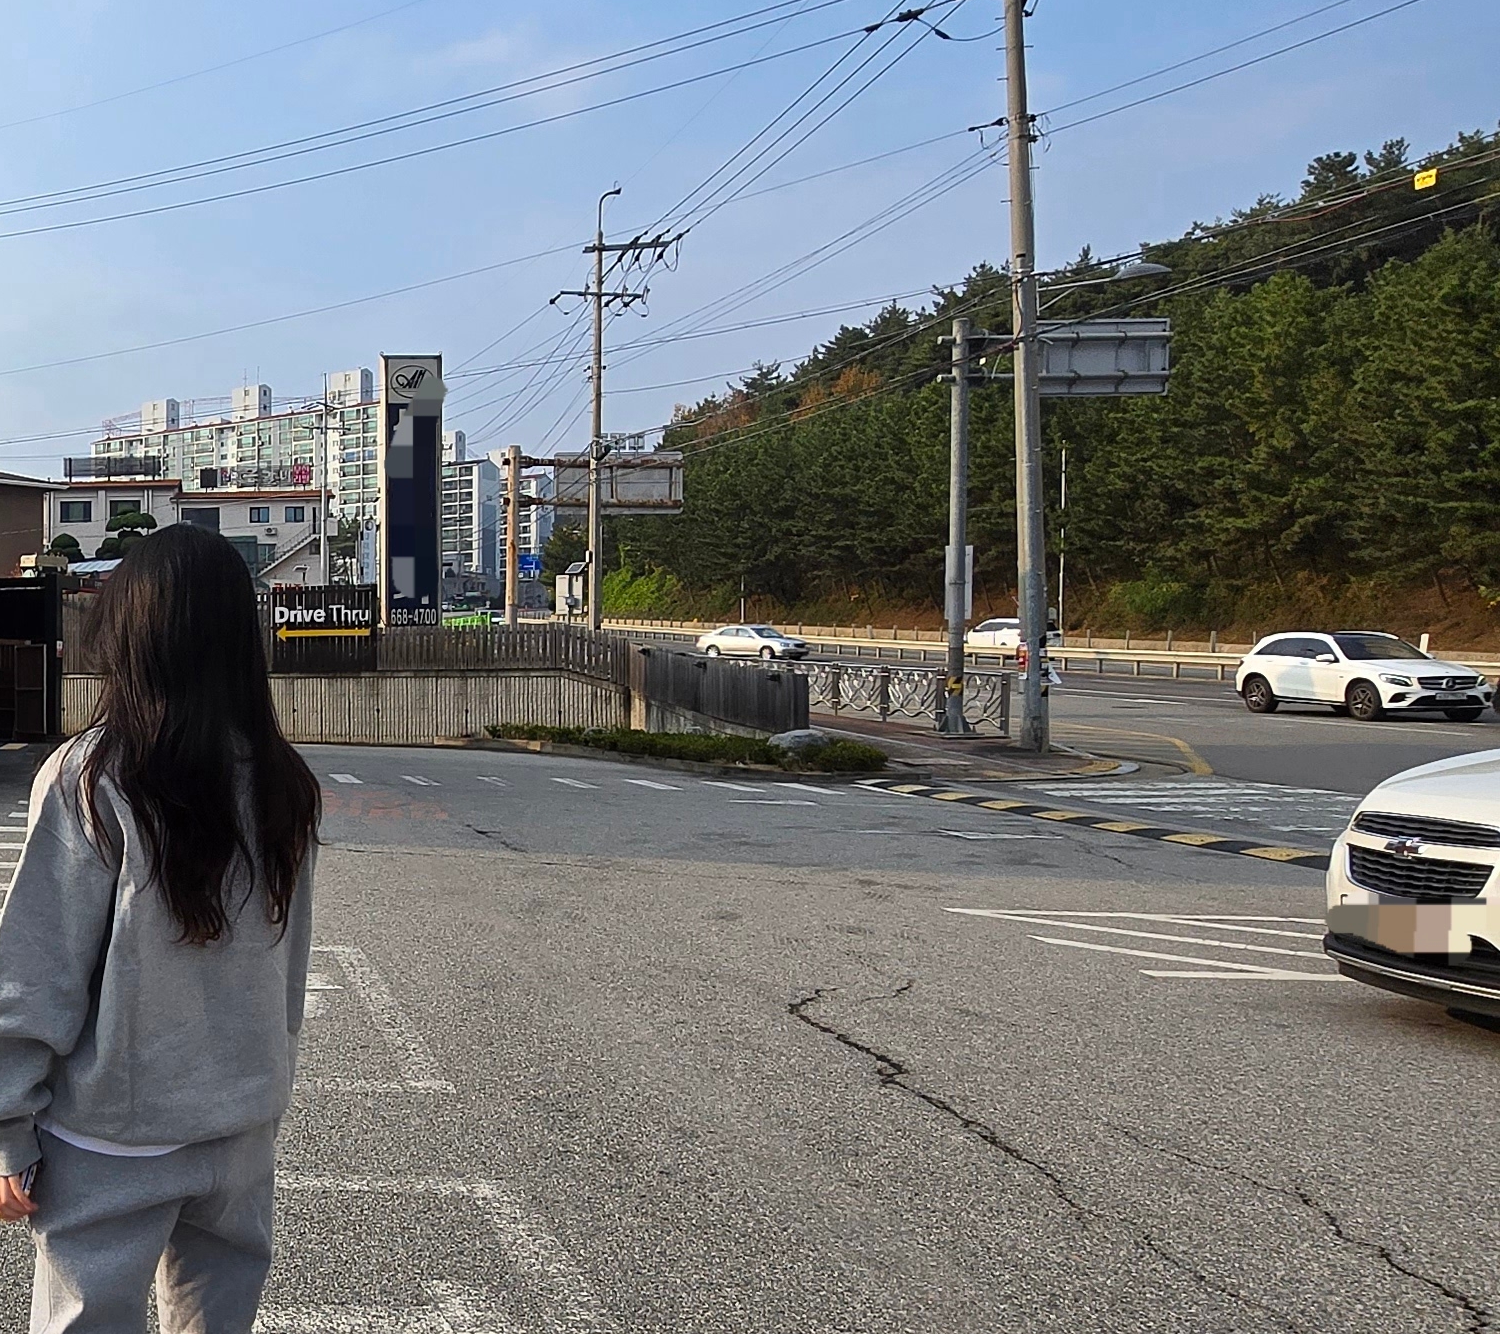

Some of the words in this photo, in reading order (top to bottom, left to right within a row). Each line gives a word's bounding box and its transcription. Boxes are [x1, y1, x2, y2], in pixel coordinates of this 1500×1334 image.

[274, 606, 326, 624] Drive
[329, 605, 369, 622] Thru
[391, 608, 437, 625] 668-4700
